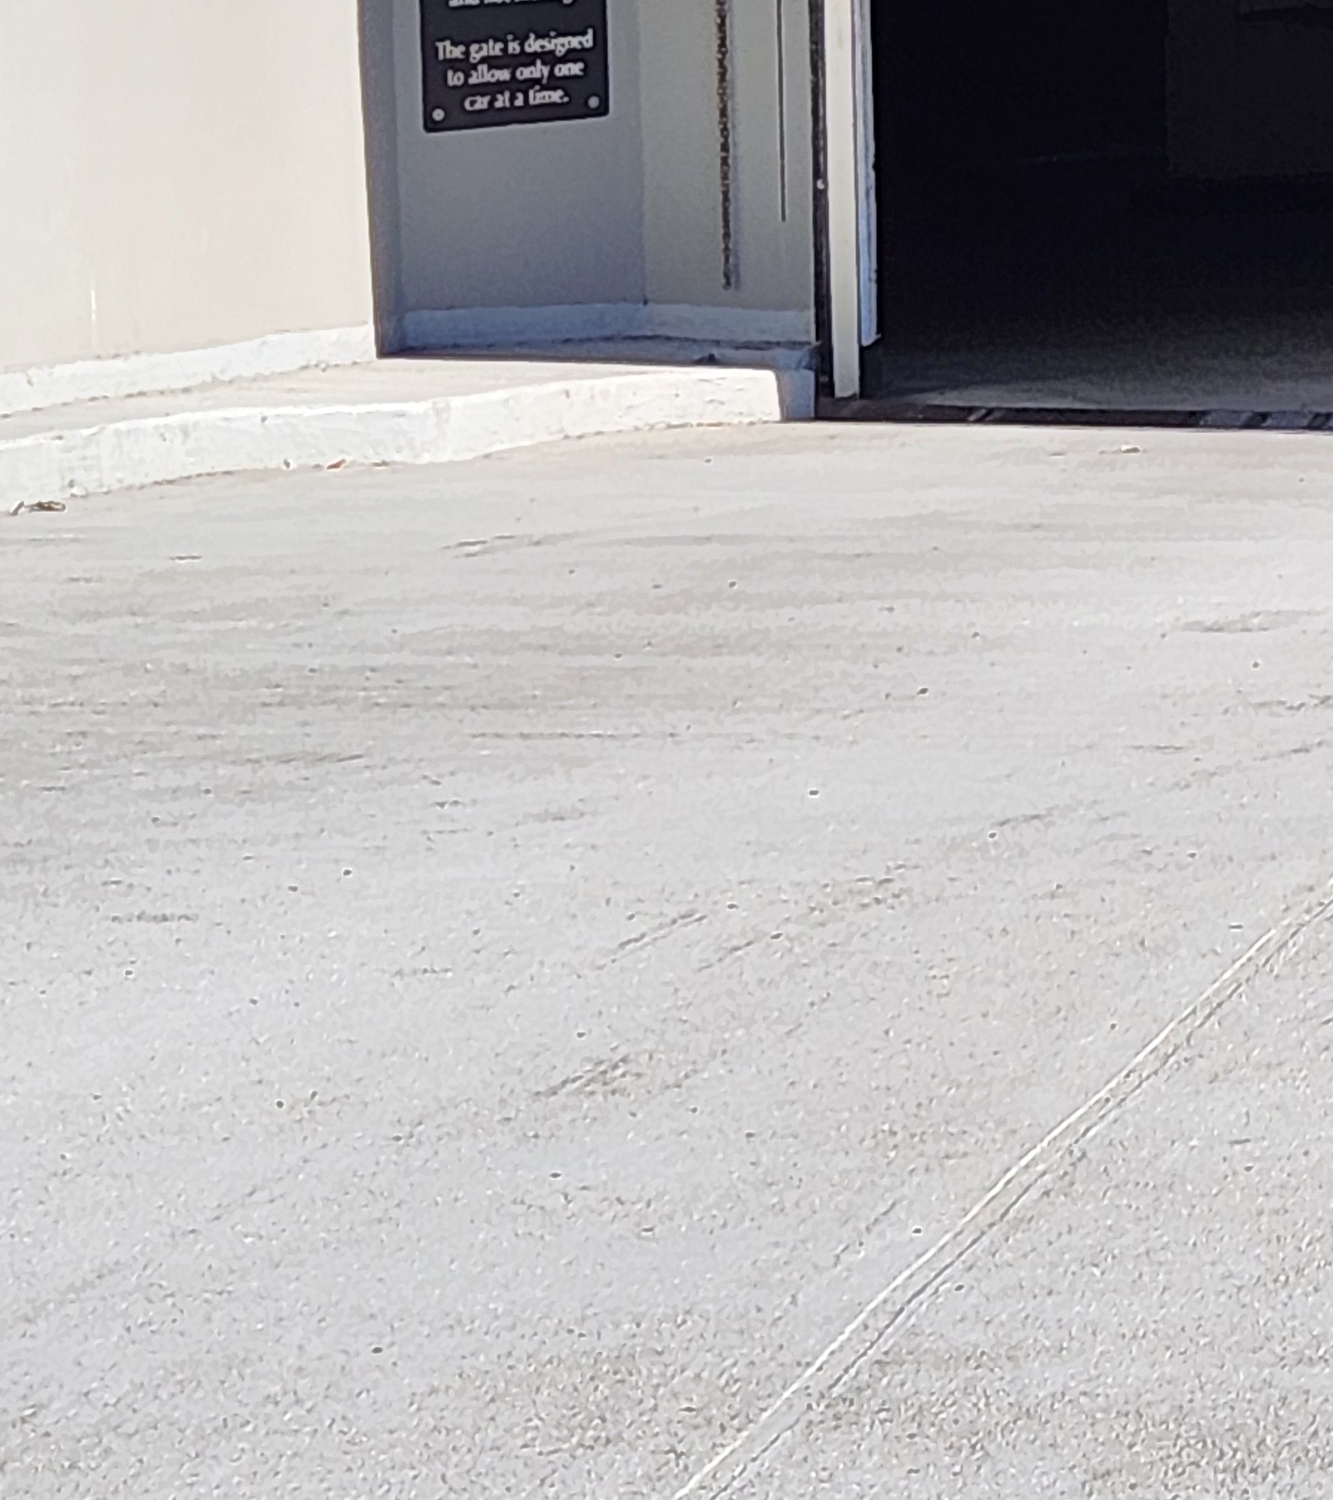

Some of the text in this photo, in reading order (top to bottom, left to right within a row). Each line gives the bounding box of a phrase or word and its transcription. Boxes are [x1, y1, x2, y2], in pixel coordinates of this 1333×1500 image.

[436, 28, 593, 63] The gate is designed
[447, 59, 584, 86] to allow only one
[464, 85, 569, 111] car at a time.
